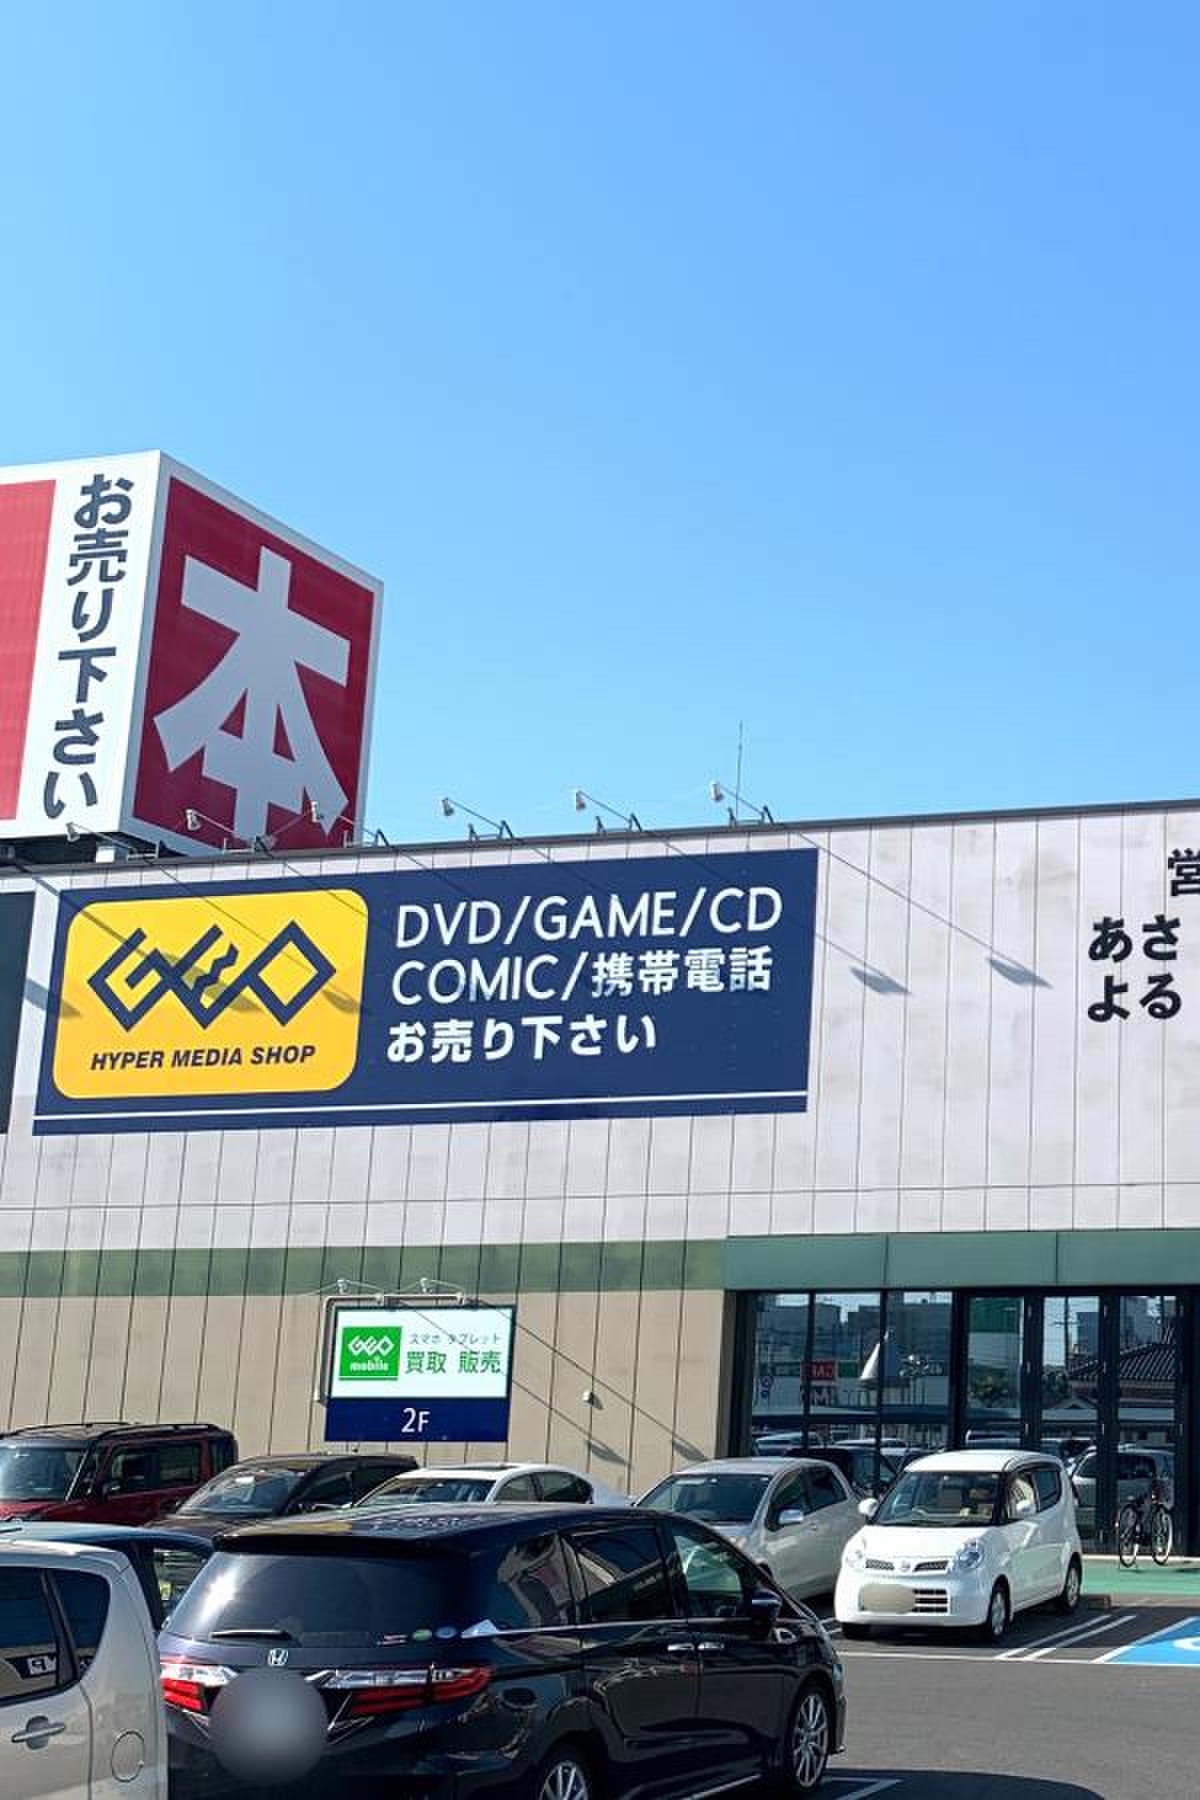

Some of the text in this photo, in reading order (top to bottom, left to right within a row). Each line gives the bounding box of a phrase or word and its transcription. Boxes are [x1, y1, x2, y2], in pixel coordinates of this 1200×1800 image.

[44, 474, 134, 818] お売り下さい
[153, 545, 350, 841] 本
[396, 886, 783, 948] DVD/GAME/CD
[1088, 915, 1181, 963] あさ
[87, 919, 337, 1032] GEO
[391, 945, 773, 1005] COMIC/携帯電話
[1088, 972, 1182, 1022] よる
[90, 1045, 316, 1071] HYPER MEDIA SHOP
[386, 1014, 657, 1063] お売り下さい
[348, 1335, 395, 1357] GEO
[405, 1350, 502, 1374] 買取 販売
[410, 1334, 442, 1344] スマホ
[350, 1358, 389, 1371] mobile
[401, 1407, 430, 1433] 2F
